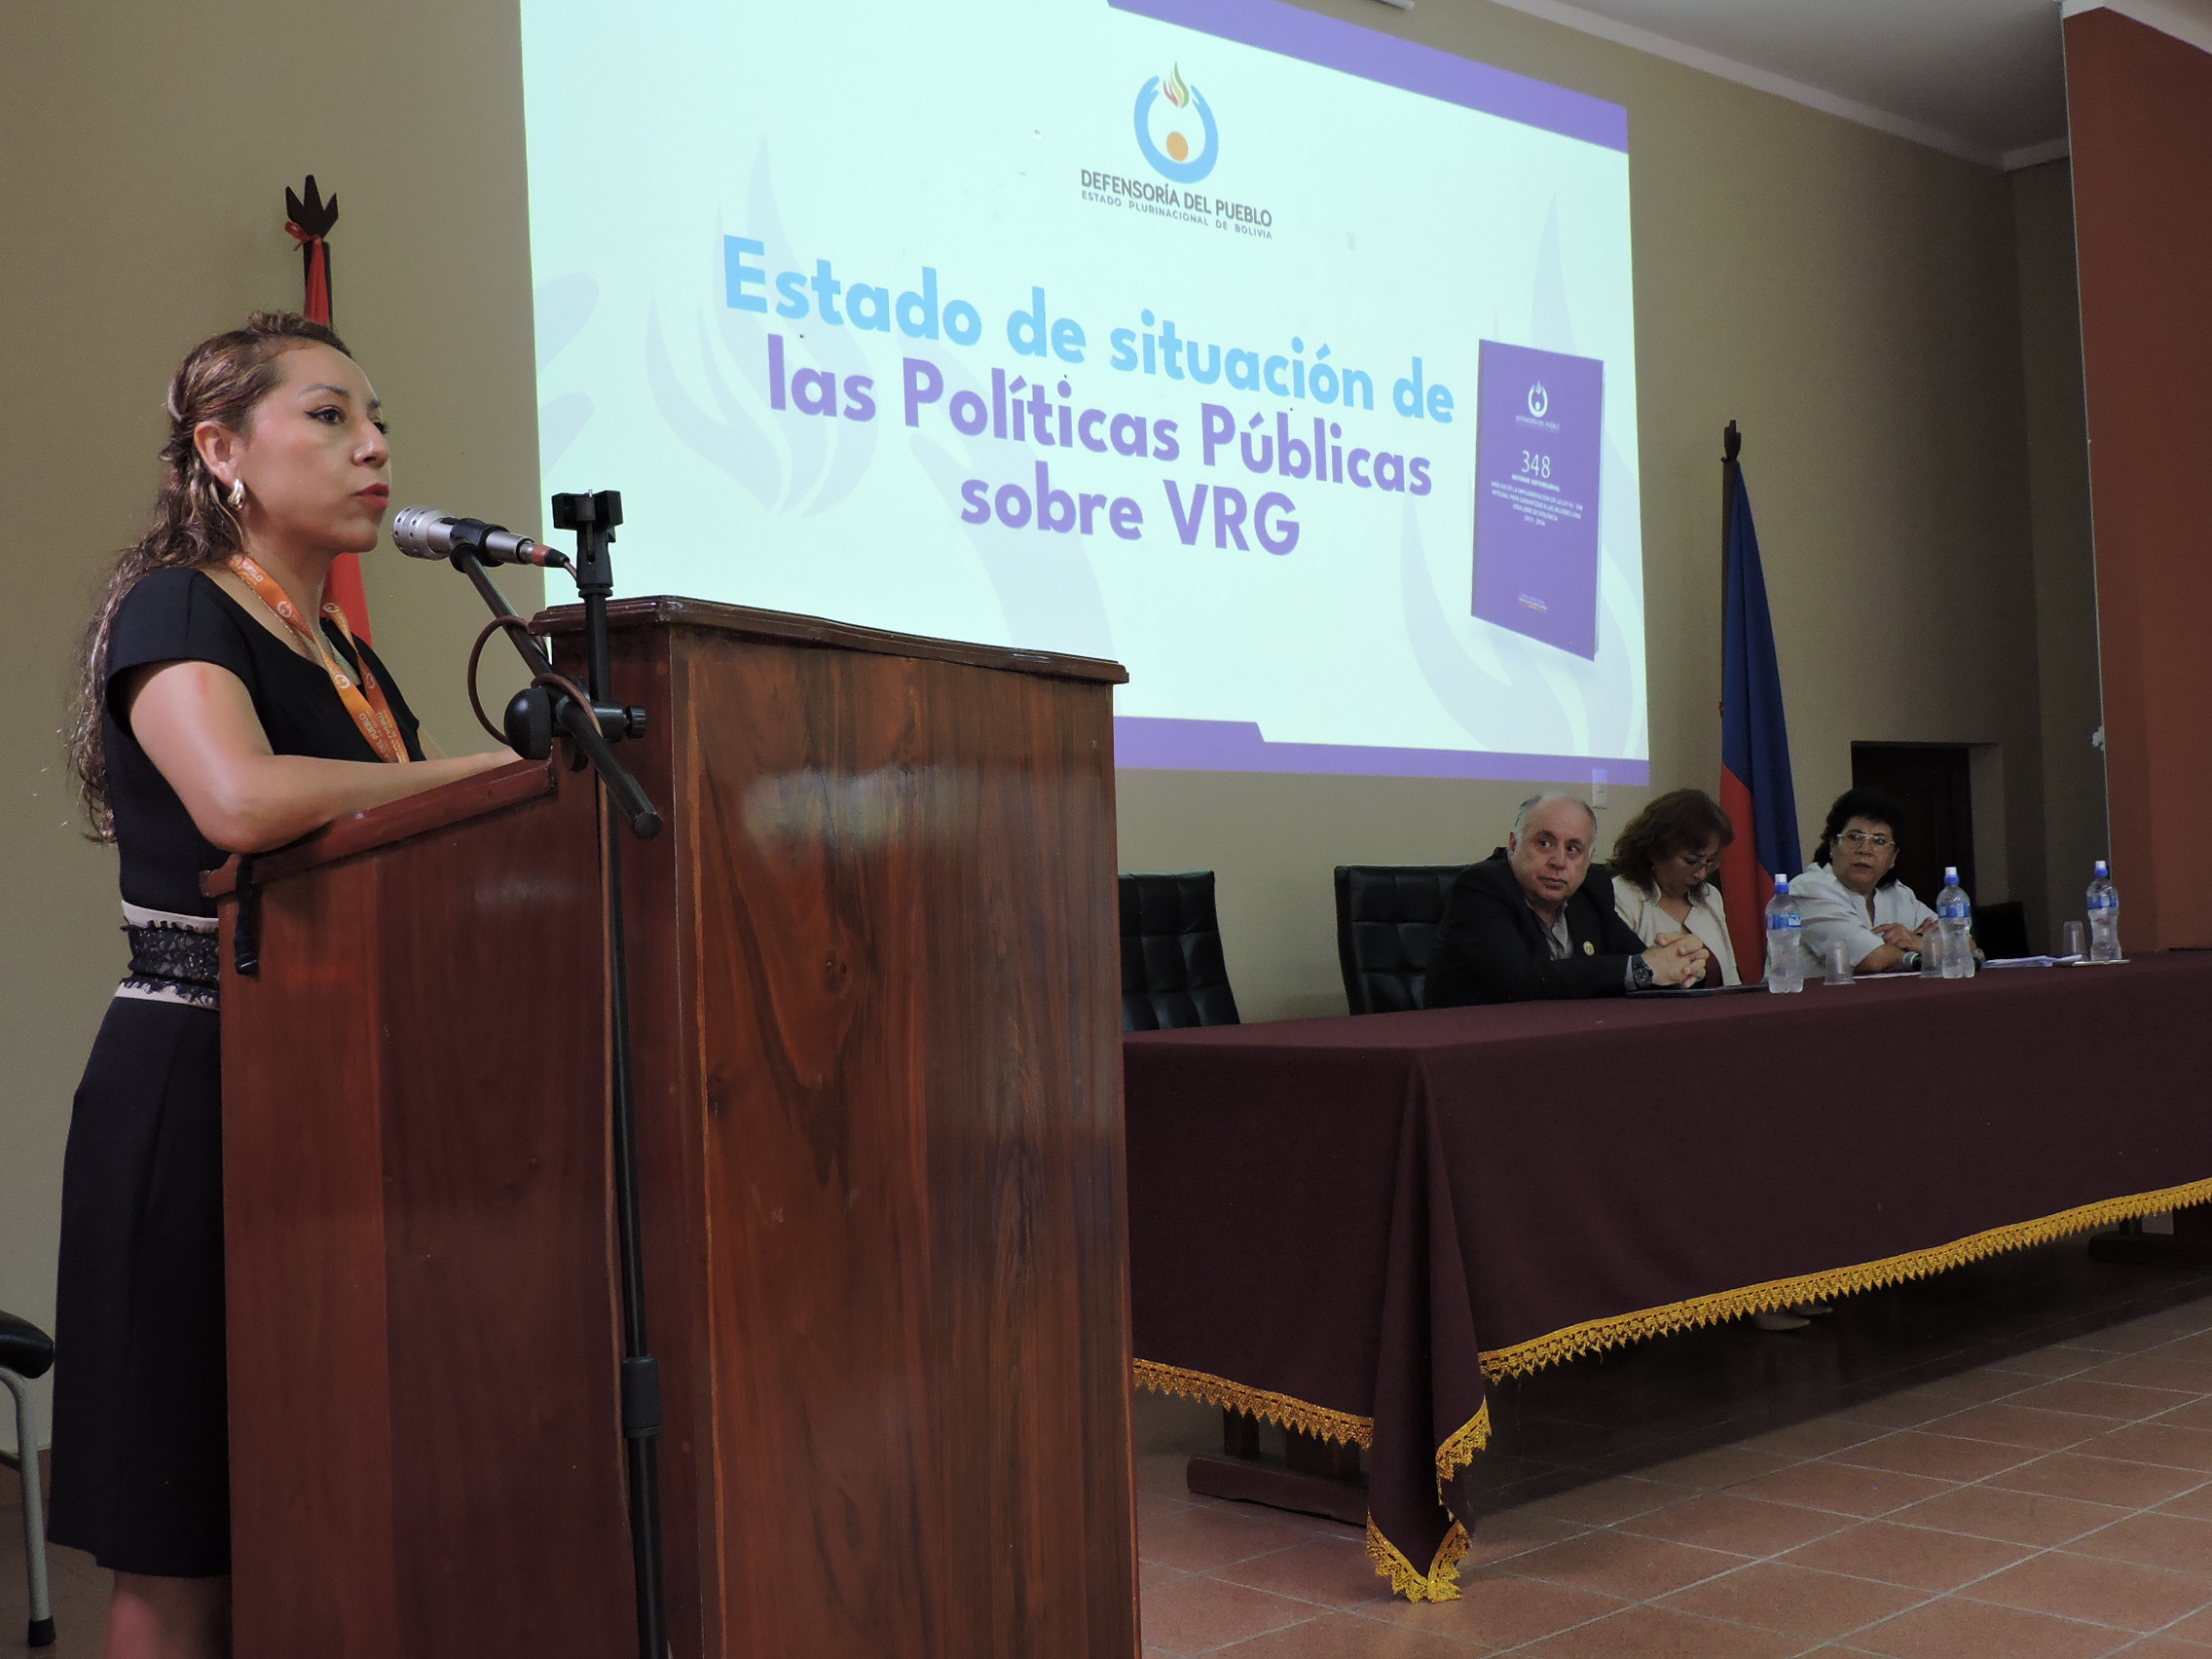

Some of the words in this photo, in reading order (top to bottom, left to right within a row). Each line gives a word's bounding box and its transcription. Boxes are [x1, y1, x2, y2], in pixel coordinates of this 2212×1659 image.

[1081, 168, 1180, 207] DEFENSORÍA
[1184, 192, 1211, 214] DEL
[1215, 199, 1272, 228] PUEBLO
[1082, 190, 1123, 206] ESTADO
[1128, 200, 1209, 226] PLURINACIONAL
[1215, 219, 1229, 230] DE
[1235, 223, 1272, 240] BOLIVIA
[723, 235, 981, 347] Estado
[1007, 286, 1087, 364] de
[1110, 309, 1374, 411] situación
[1392, 356, 1455, 424] de
[767, 333, 876, 423] las
[903, 357, 1180, 462] Políticas
[1200, 402, 1432, 497] Públicas
[1521, 450, 1551, 478] 348
[961, 461, 1144, 541] sobre
[1162, 479, 1300, 556] VRG
[359, 713, 379, 740] PUEBLO
